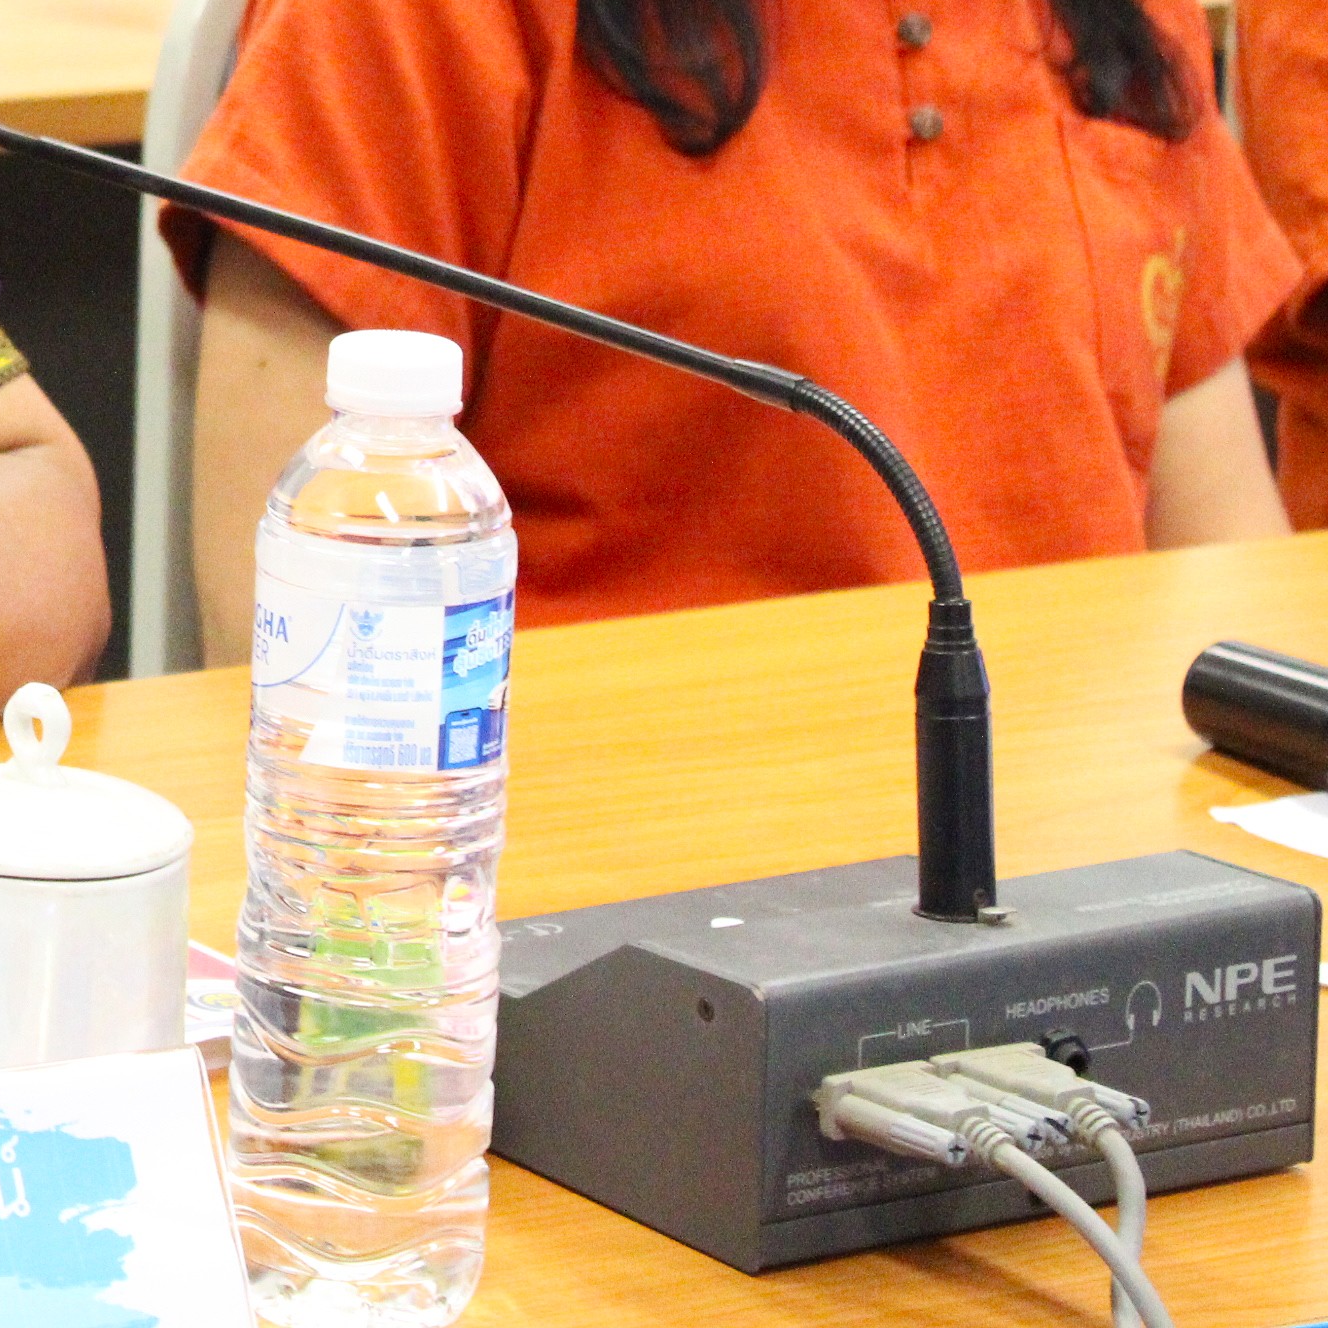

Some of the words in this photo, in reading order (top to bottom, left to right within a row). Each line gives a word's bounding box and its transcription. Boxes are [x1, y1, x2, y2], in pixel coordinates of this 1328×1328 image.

[255, 603, 289, 644] GHA
[1184, 953, 1299, 1009] NPE
[1004, 987, 1111, 1021] HEADPHONES
[1183, 993, 1298, 1023] RESEARCH
[896, 1018, 933, 1040] LINE
[1172, 1108, 1244, 1135] (THAILAND)
